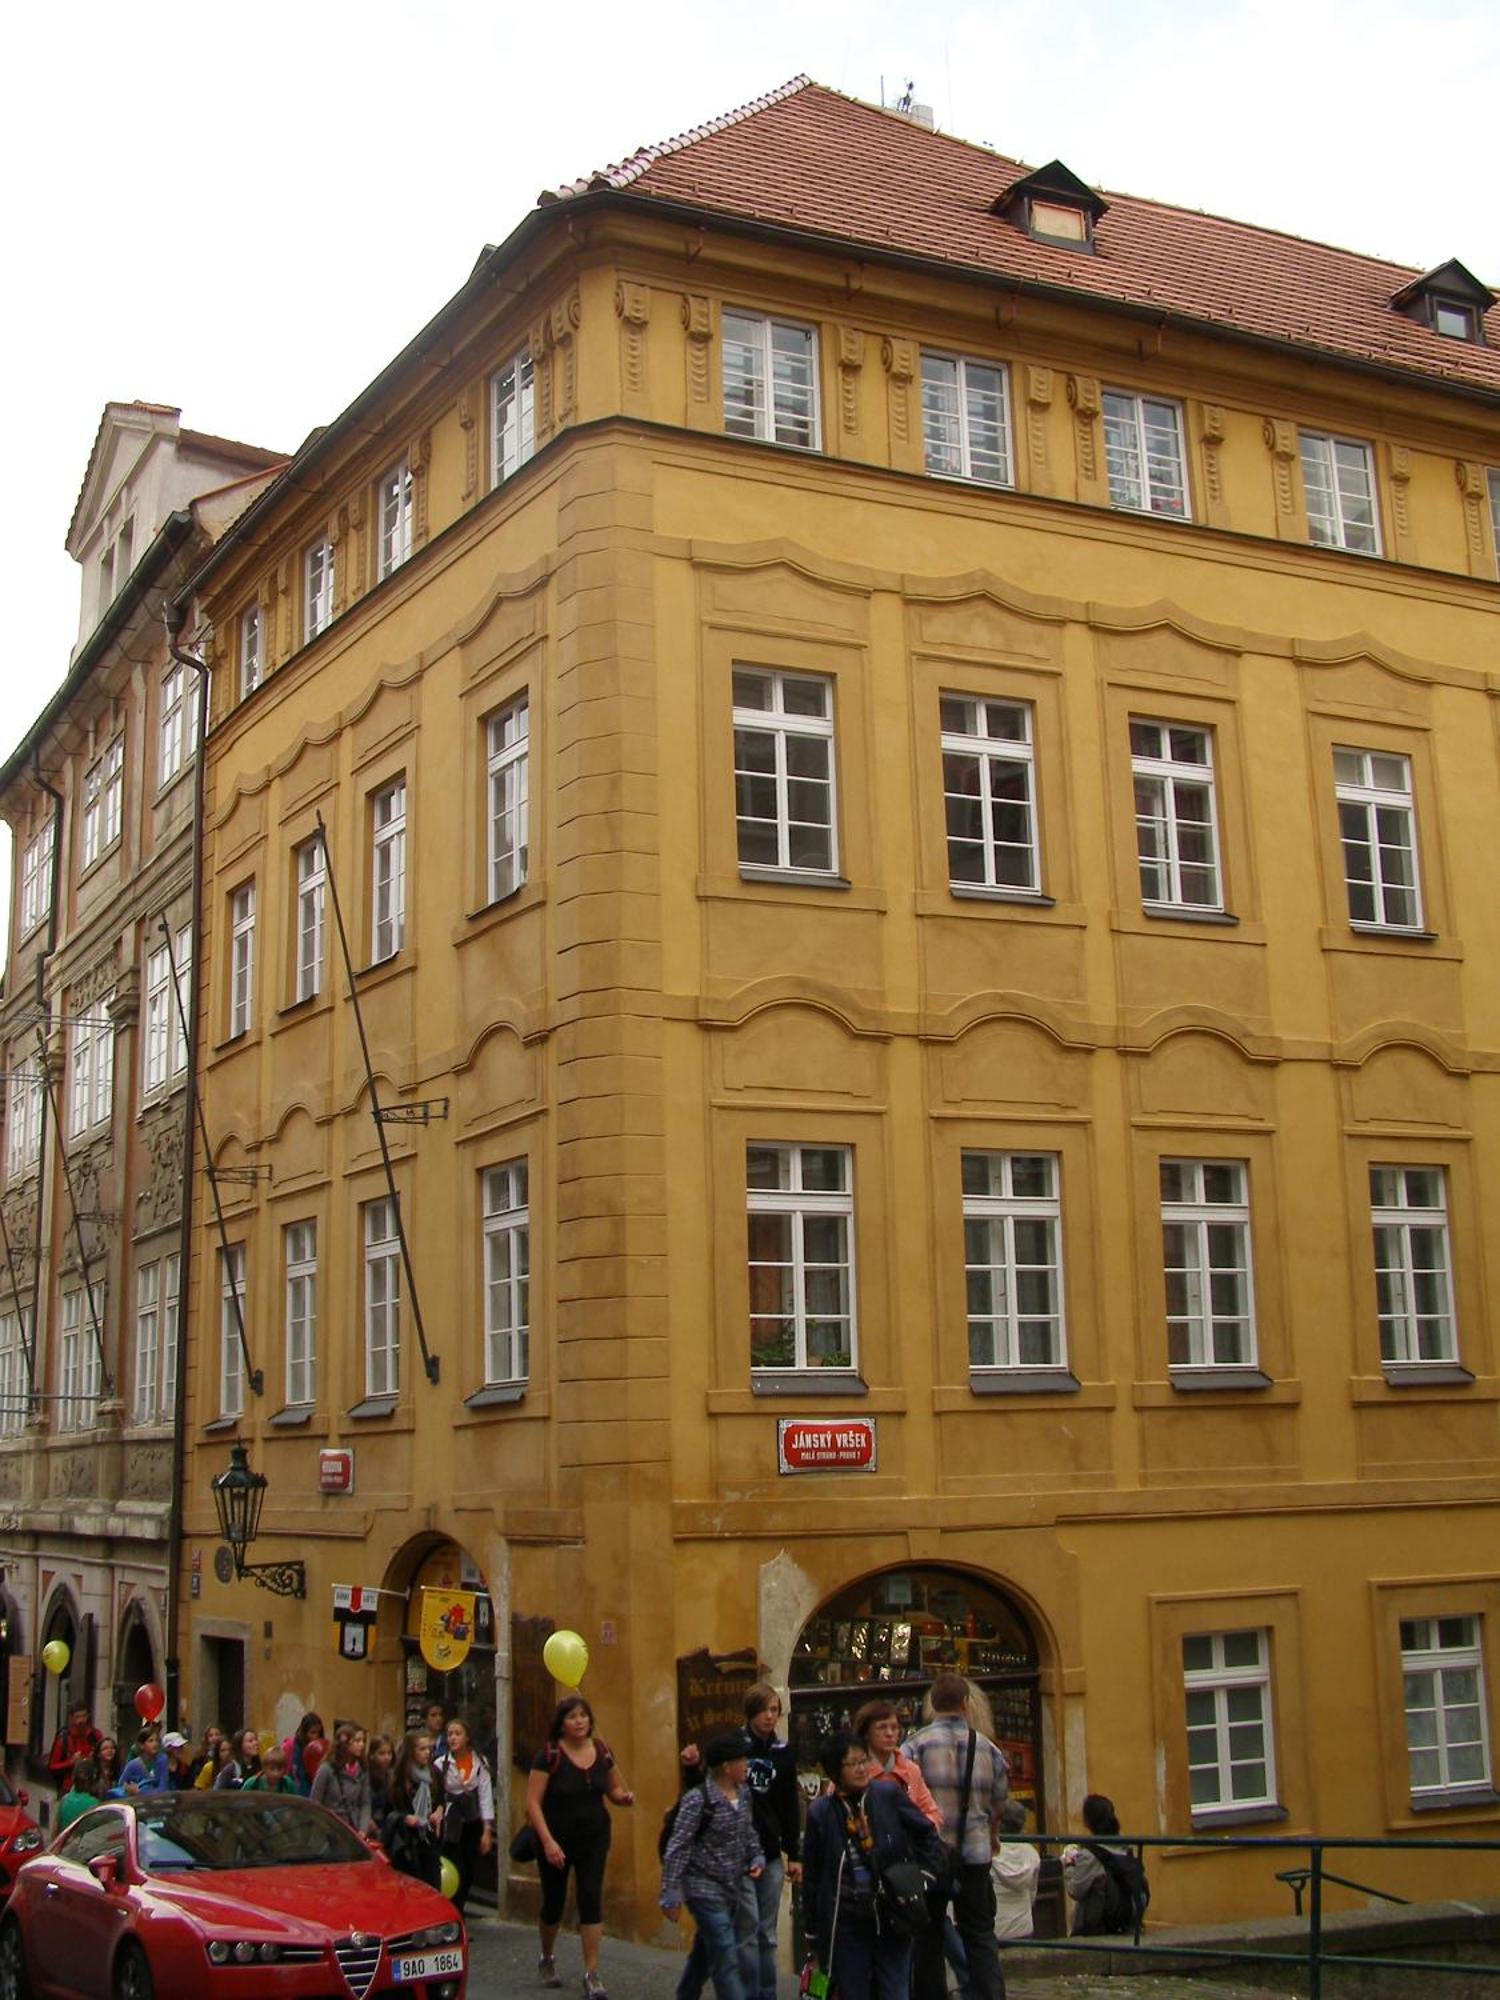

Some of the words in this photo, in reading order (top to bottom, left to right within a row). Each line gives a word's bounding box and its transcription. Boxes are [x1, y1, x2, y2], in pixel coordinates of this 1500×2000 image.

[792, 1431, 832, 1449] JÁNSKÝ
[836, 1430, 867, 1448] VRŠEK
[403, 1959, 425, 1977] 9A0
[434, 1954, 458, 1972] 1864
